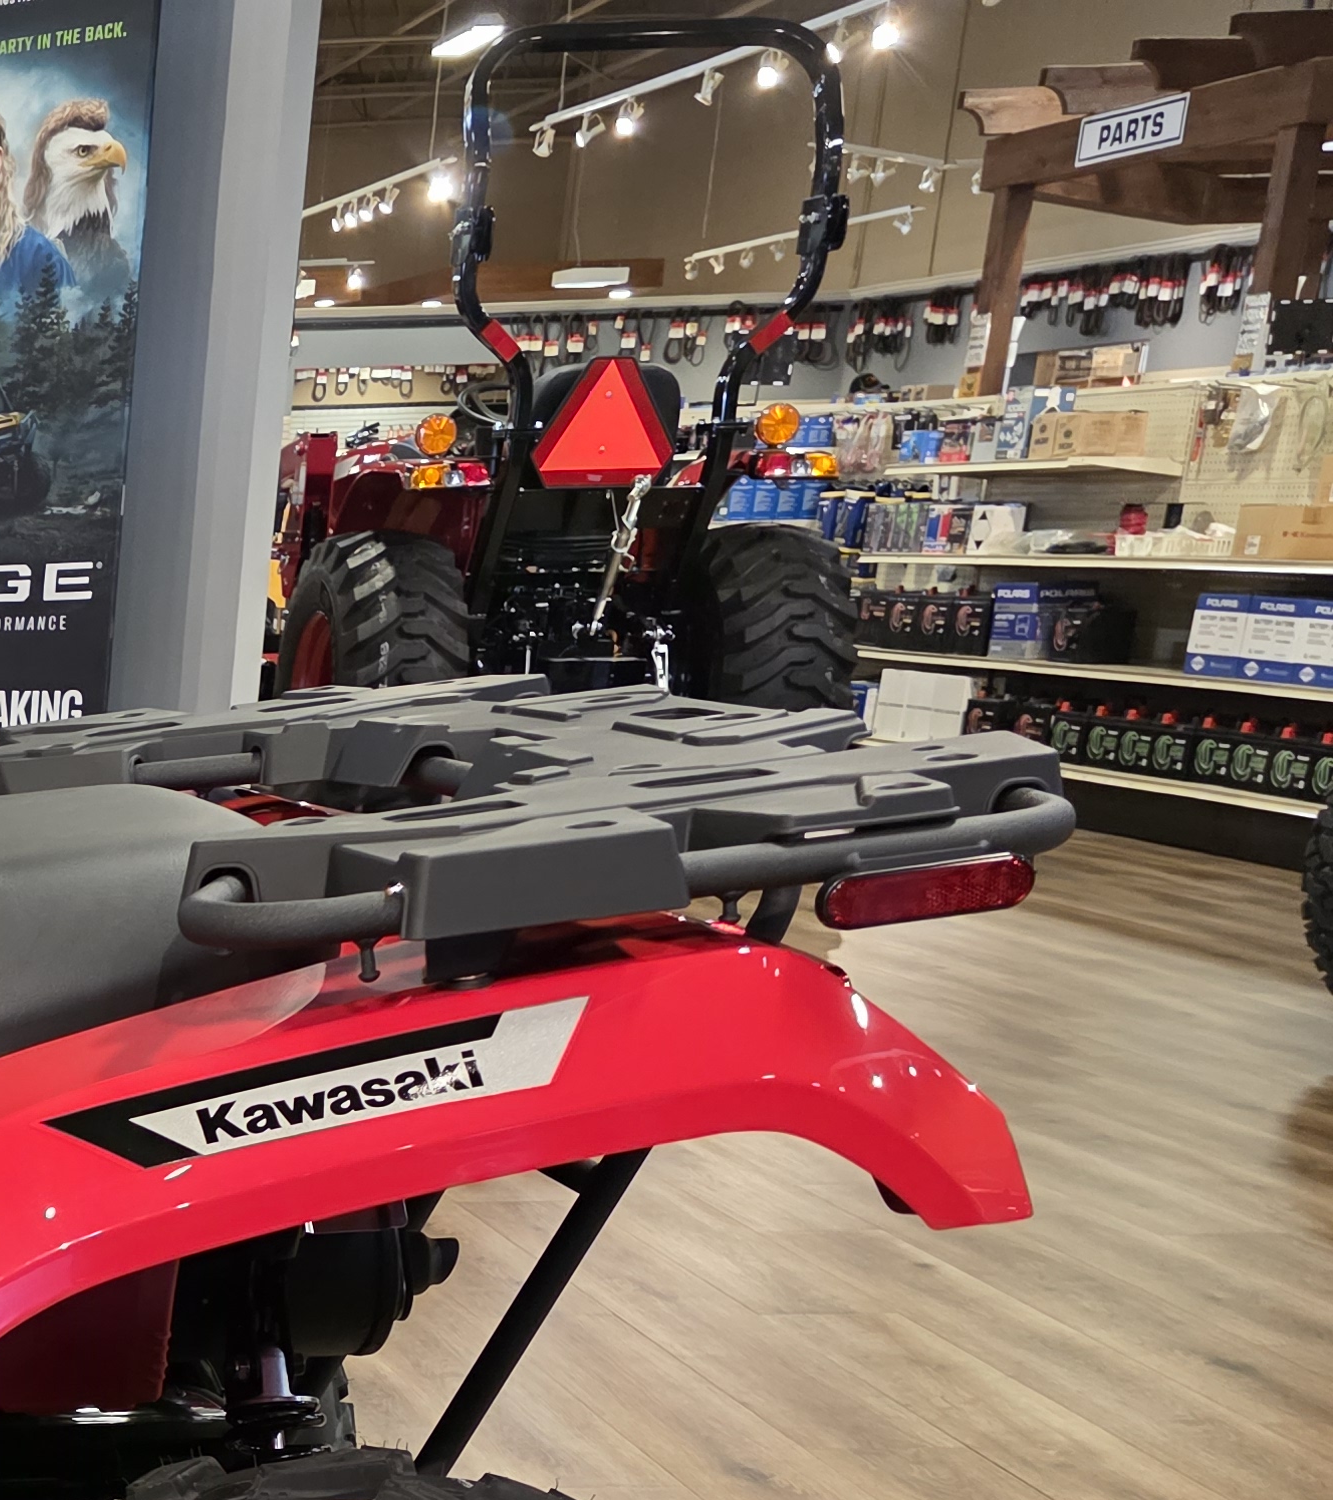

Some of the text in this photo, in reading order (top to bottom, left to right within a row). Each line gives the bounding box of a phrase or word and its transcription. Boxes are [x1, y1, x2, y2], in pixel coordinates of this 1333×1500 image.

[37, 33, 52, 50] IN
[55, 28, 82, 46] THE
[85, 21, 128, 43] BACK.
[1098, 111, 1165, 150] PARTS
[997, 589, 1031, 599] POLARIS
[1206, 598, 1239, 609] POLARIS
[1260, 602, 1295, 613] POLARIS
[195, 1050, 485, 1144] Kawasaki
